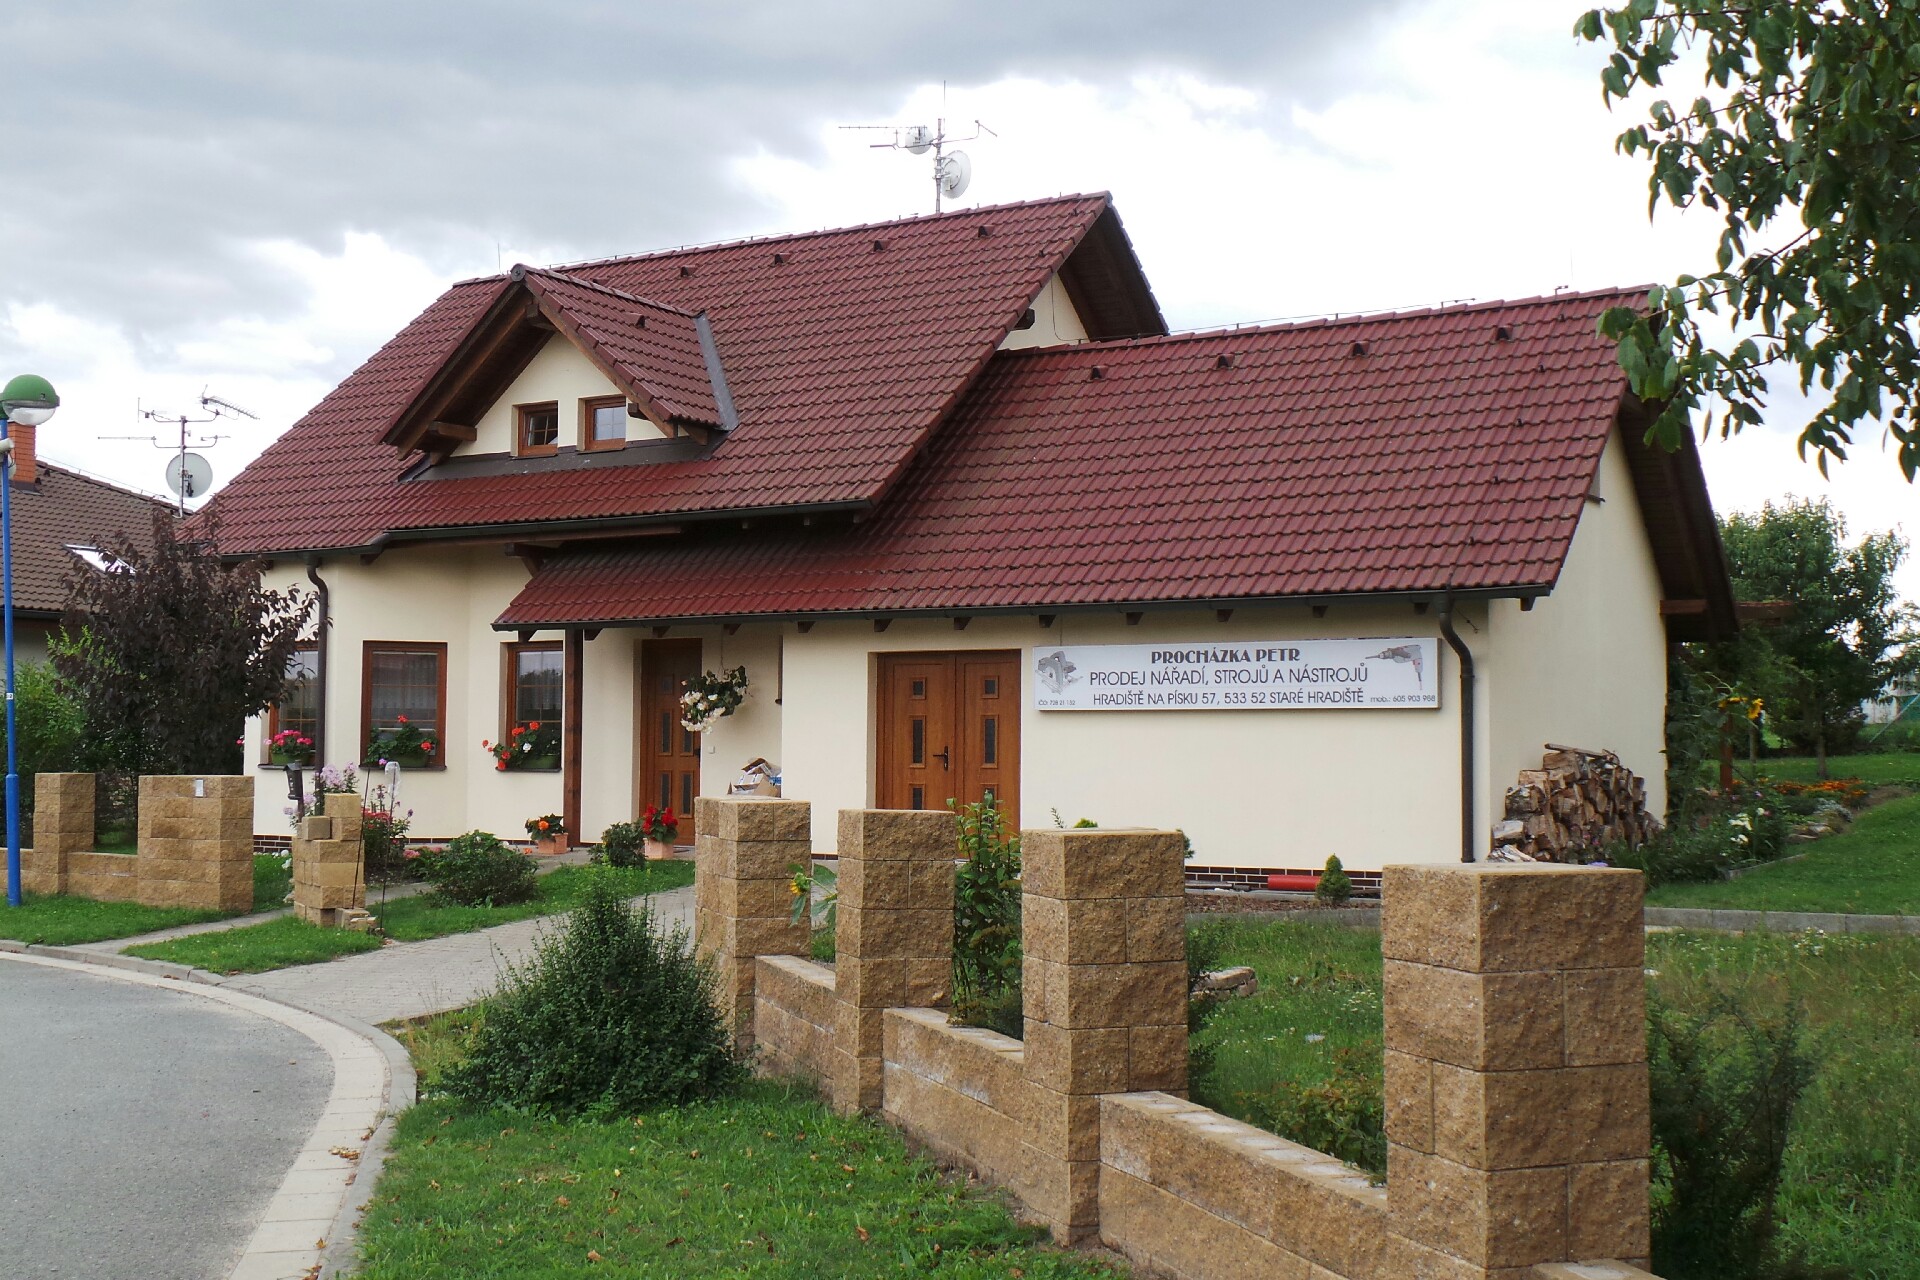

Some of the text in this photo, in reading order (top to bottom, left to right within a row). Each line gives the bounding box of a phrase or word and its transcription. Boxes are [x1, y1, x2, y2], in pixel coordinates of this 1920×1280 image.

[1151, 647, 1300, 663] PROCHÁZKA PETR
[1090, 662, 1368, 685] PRODEJ NÁŘADÍ, STROJŮ A NÁSTROJŮ
[1093, 688, 1364, 705] HRADIŠTĚ NA PÍSKU 57, 533 52 STARÉ HRADIŠTĚ
[1408, 694, 1420, 702] 903
